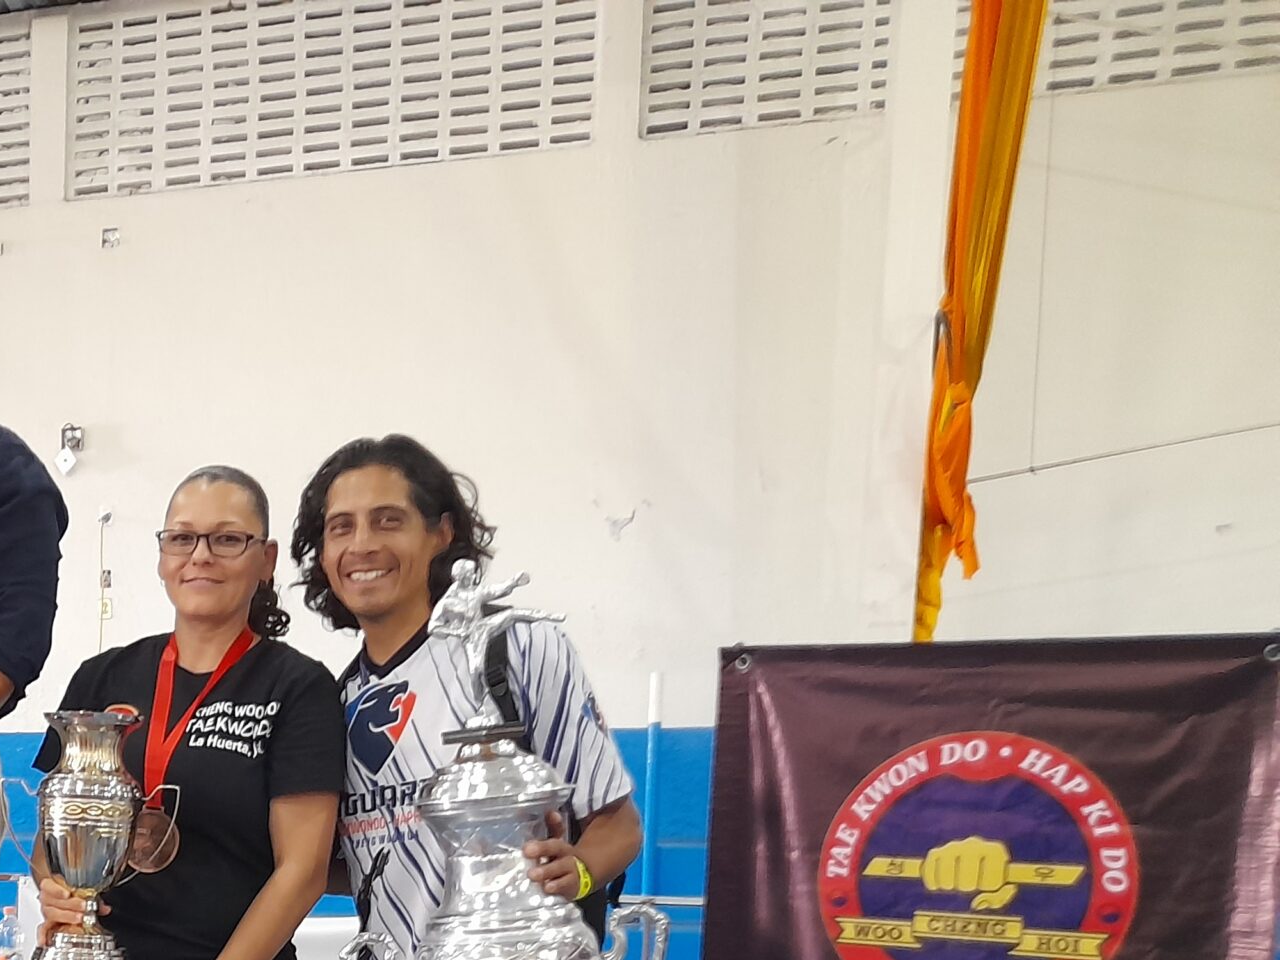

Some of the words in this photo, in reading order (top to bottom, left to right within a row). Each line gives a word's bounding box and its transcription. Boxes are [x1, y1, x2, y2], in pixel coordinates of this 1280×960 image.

[196, 701, 233, 717] CHENG
[235, 704, 264, 719] WOO
[189, 735, 204, 747] La
[206, 734, 252, 757] Huerta,
[939, 739, 987, 766] DO
[851, 751, 929, 821] KWON
[1018, 748, 1090, 796] HAP
[342, 780, 418, 817] GUAR
[1081, 799, 1120, 837] KI
[826, 823, 860, 878] TAE
[1099, 847, 1130, 893] DO
[854, 924, 903, 941] WOO
[927, 916, 1007, 936] CHENG
[1036, 936, 1081, 952] HOI
